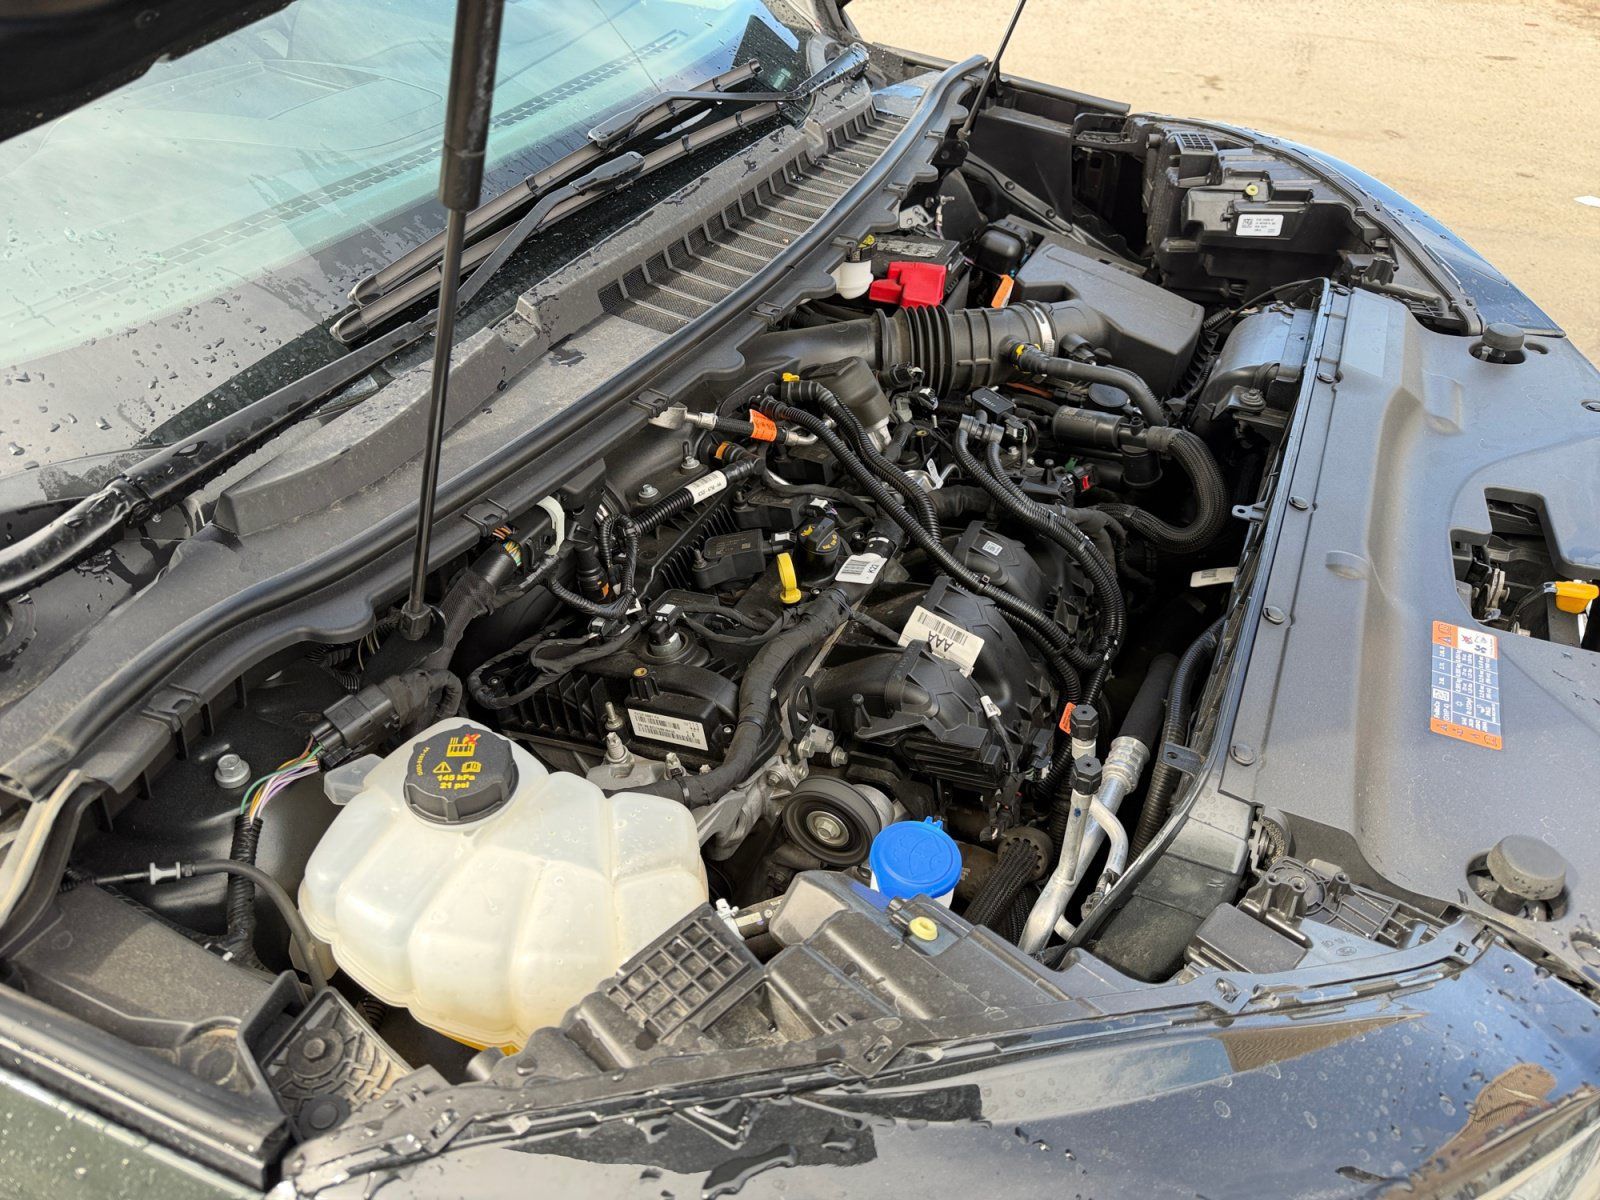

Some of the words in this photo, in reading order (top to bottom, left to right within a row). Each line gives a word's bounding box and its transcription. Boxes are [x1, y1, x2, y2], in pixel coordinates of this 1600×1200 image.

[928, 630, 954, 652] AAA
[437, 774, 455, 782] 145
[454, 781, 470, 790] psi
